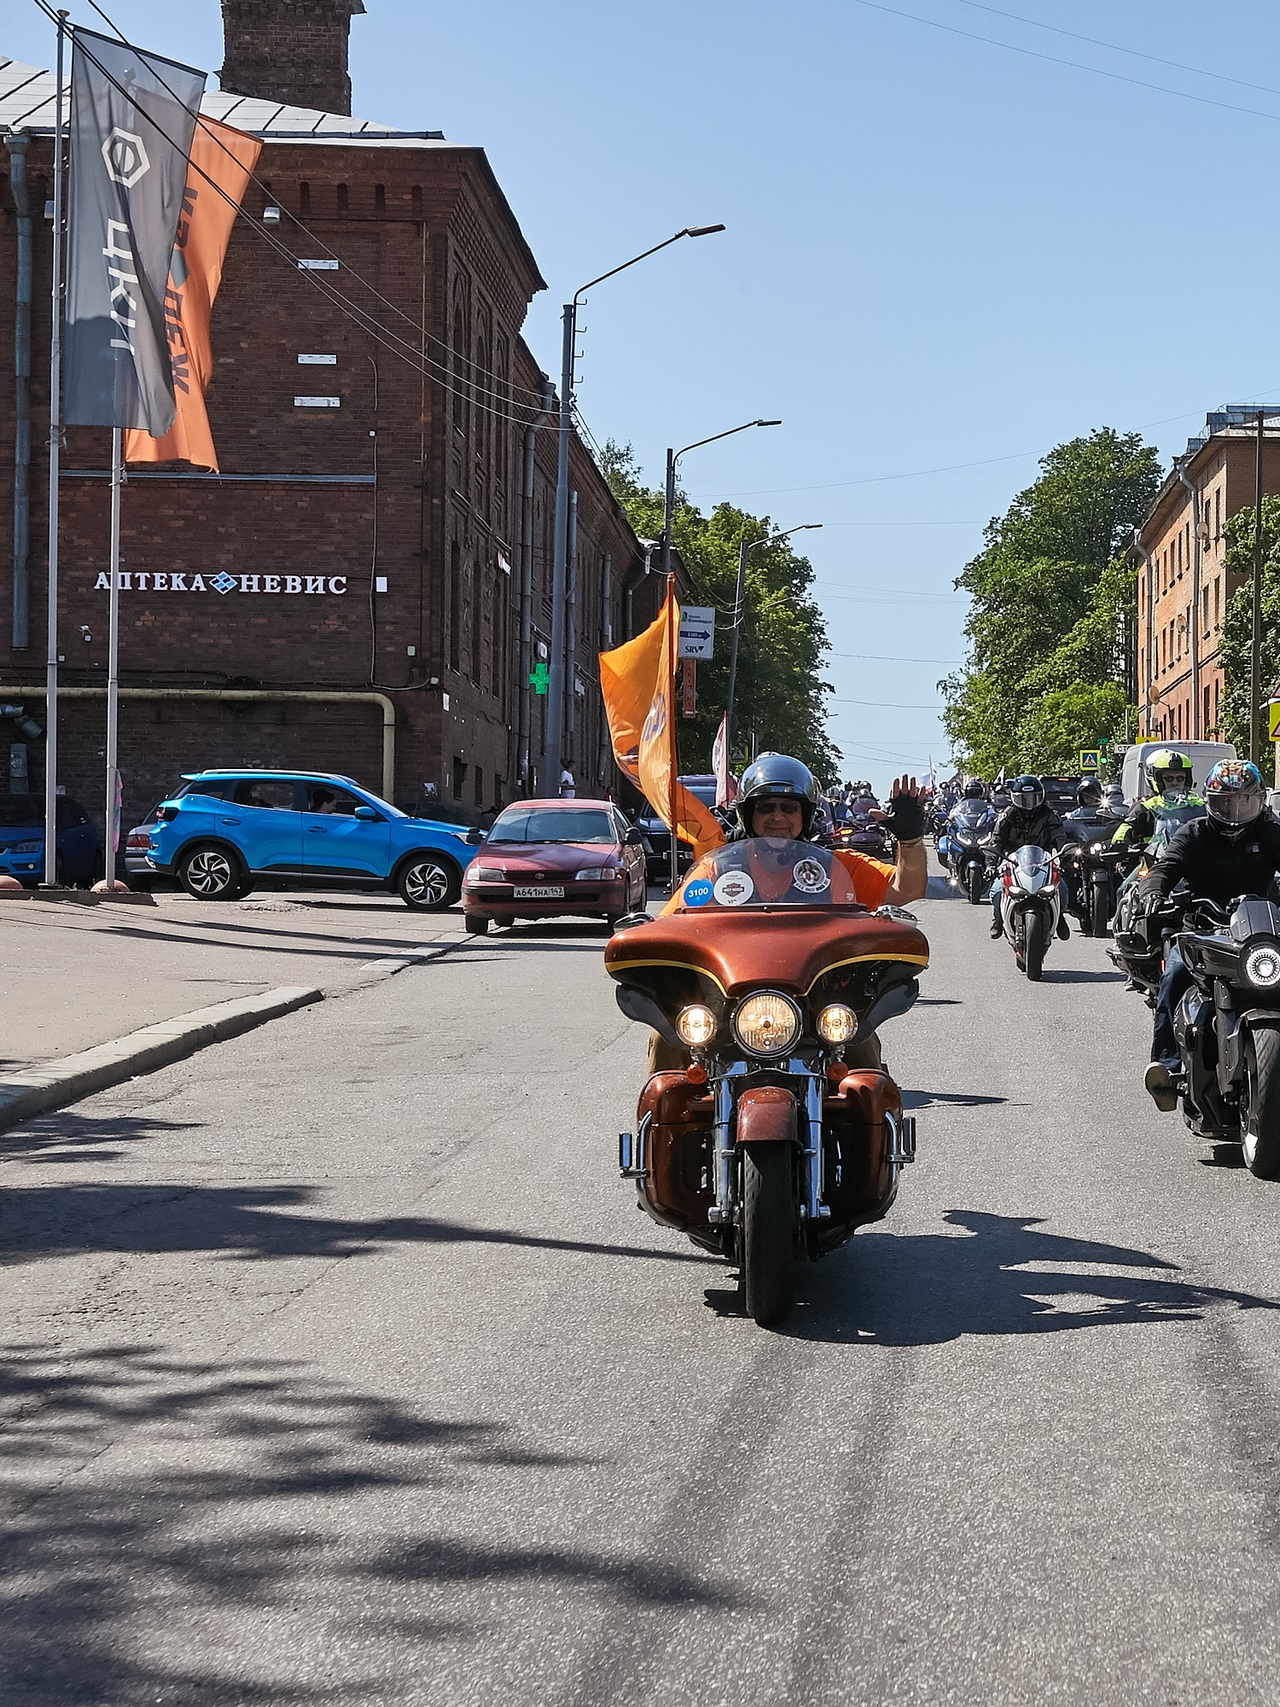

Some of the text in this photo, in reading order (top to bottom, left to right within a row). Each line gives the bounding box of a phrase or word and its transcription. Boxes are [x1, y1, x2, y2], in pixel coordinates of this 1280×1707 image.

[94, 571, 347, 595] АПТЕКА НЕВИС
[688, 887, 709, 898] 3100
